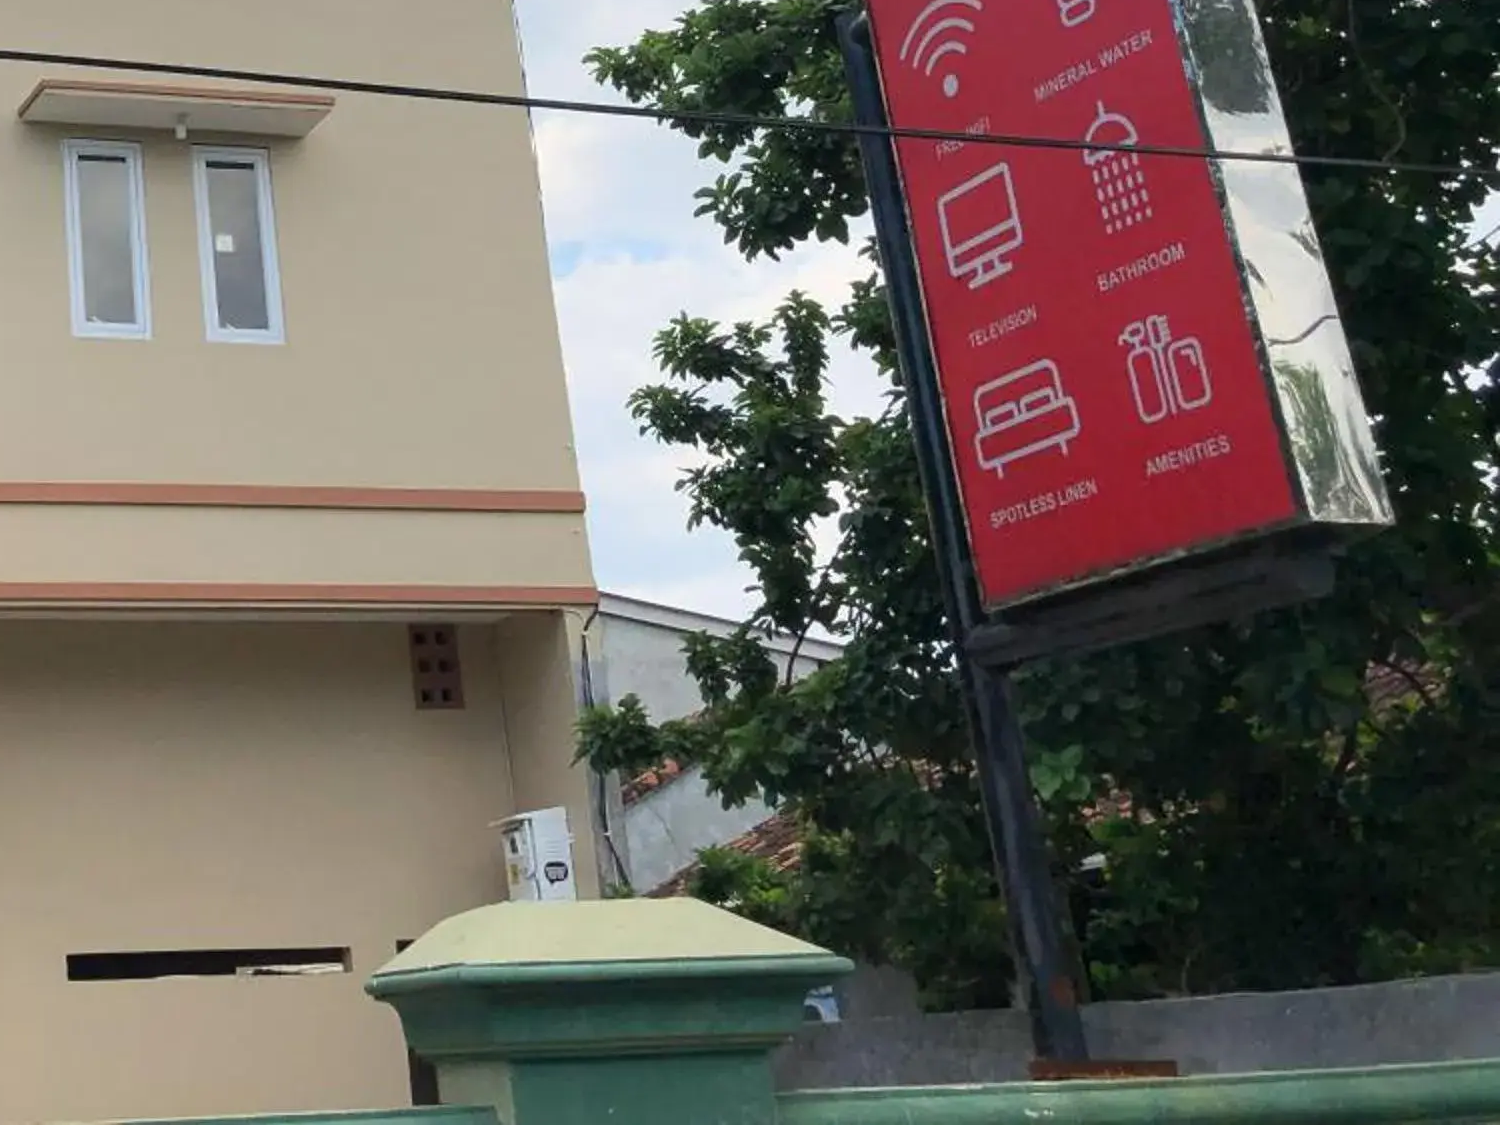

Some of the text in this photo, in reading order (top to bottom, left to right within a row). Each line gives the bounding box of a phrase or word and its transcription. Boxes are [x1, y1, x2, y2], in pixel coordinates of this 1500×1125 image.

[1033, 29, 1153, 102] MINERAL WATER
[1096, 242, 1186, 291] BATHROOM
[968, 304, 1038, 348] TELEVISION
[1145, 434, 1232, 476] AMENITIES
[990, 477, 1098, 529] SPOTLESS LINEN
